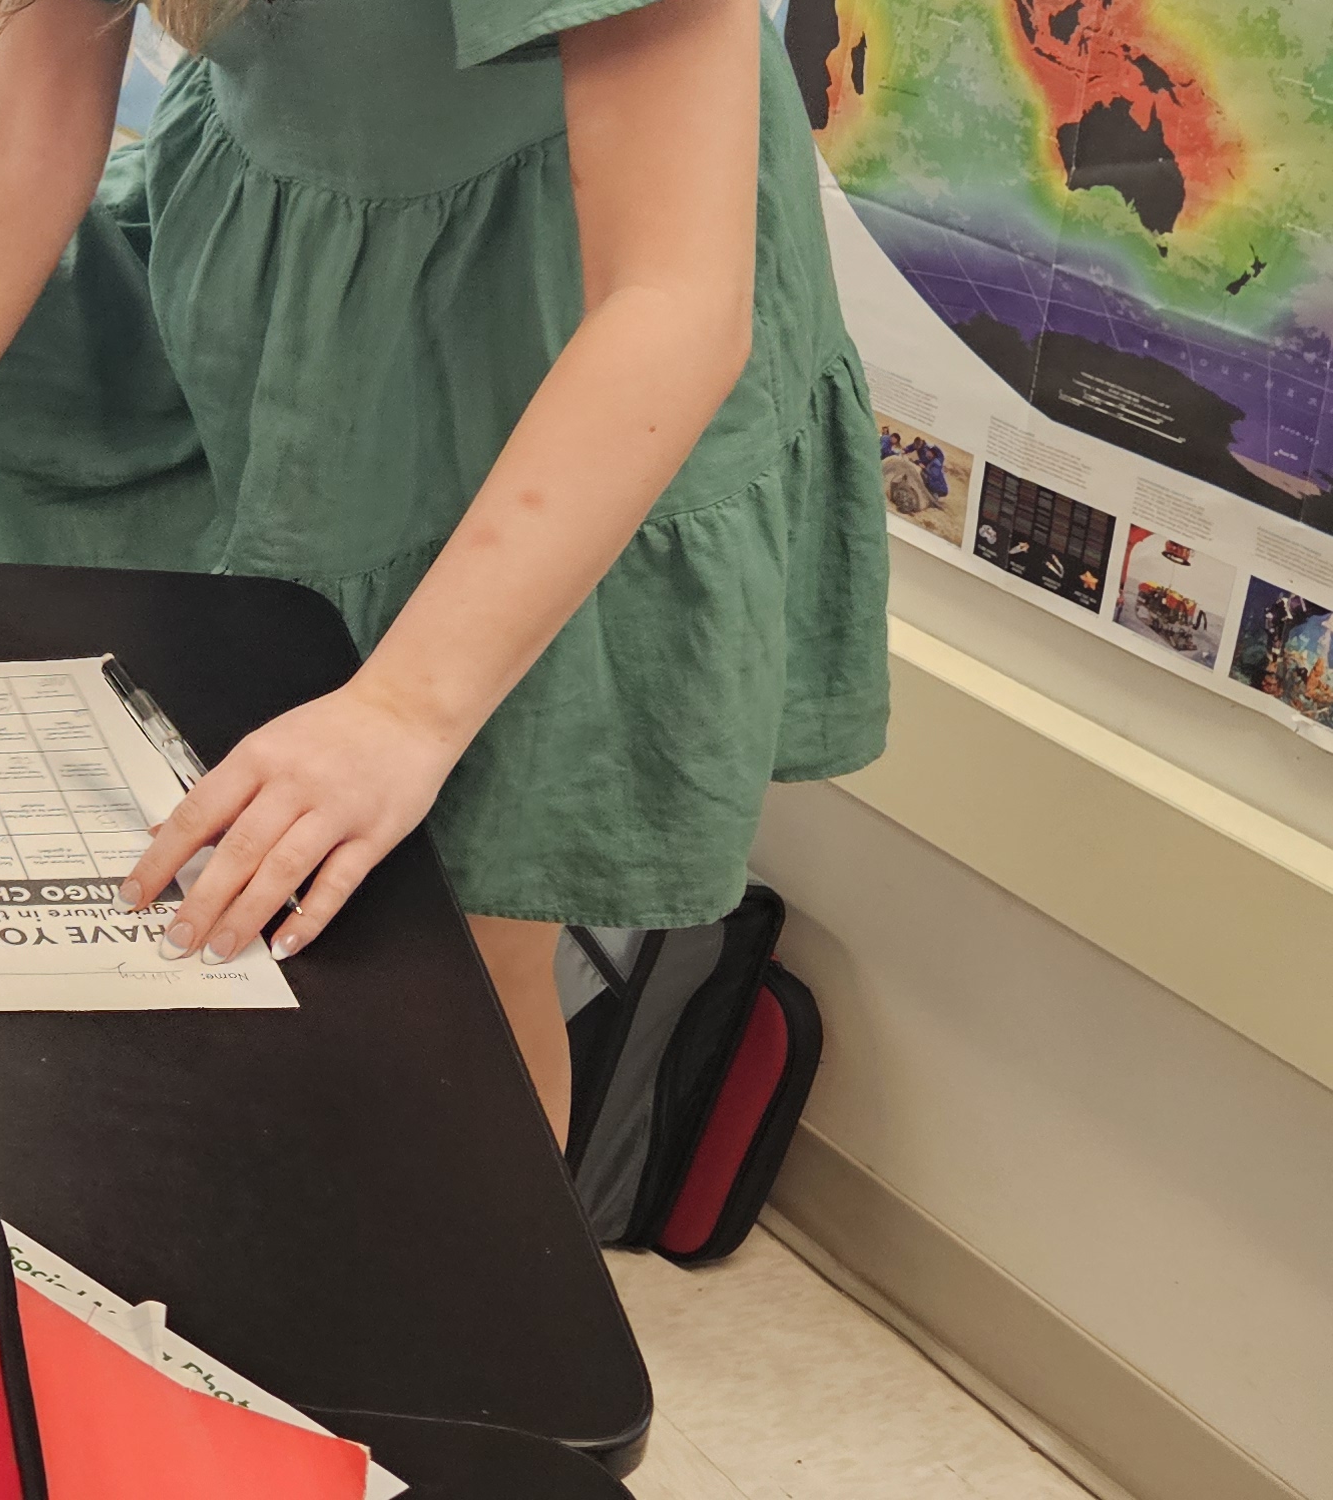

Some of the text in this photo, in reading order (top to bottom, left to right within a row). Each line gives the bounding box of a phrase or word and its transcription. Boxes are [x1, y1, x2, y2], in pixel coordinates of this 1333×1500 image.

[41, 885, 122, 902] INGO
[28, 909, 43, 921] in
[71, 925, 166, 945] HAVE
[200, 971, 250, 983] Name:
